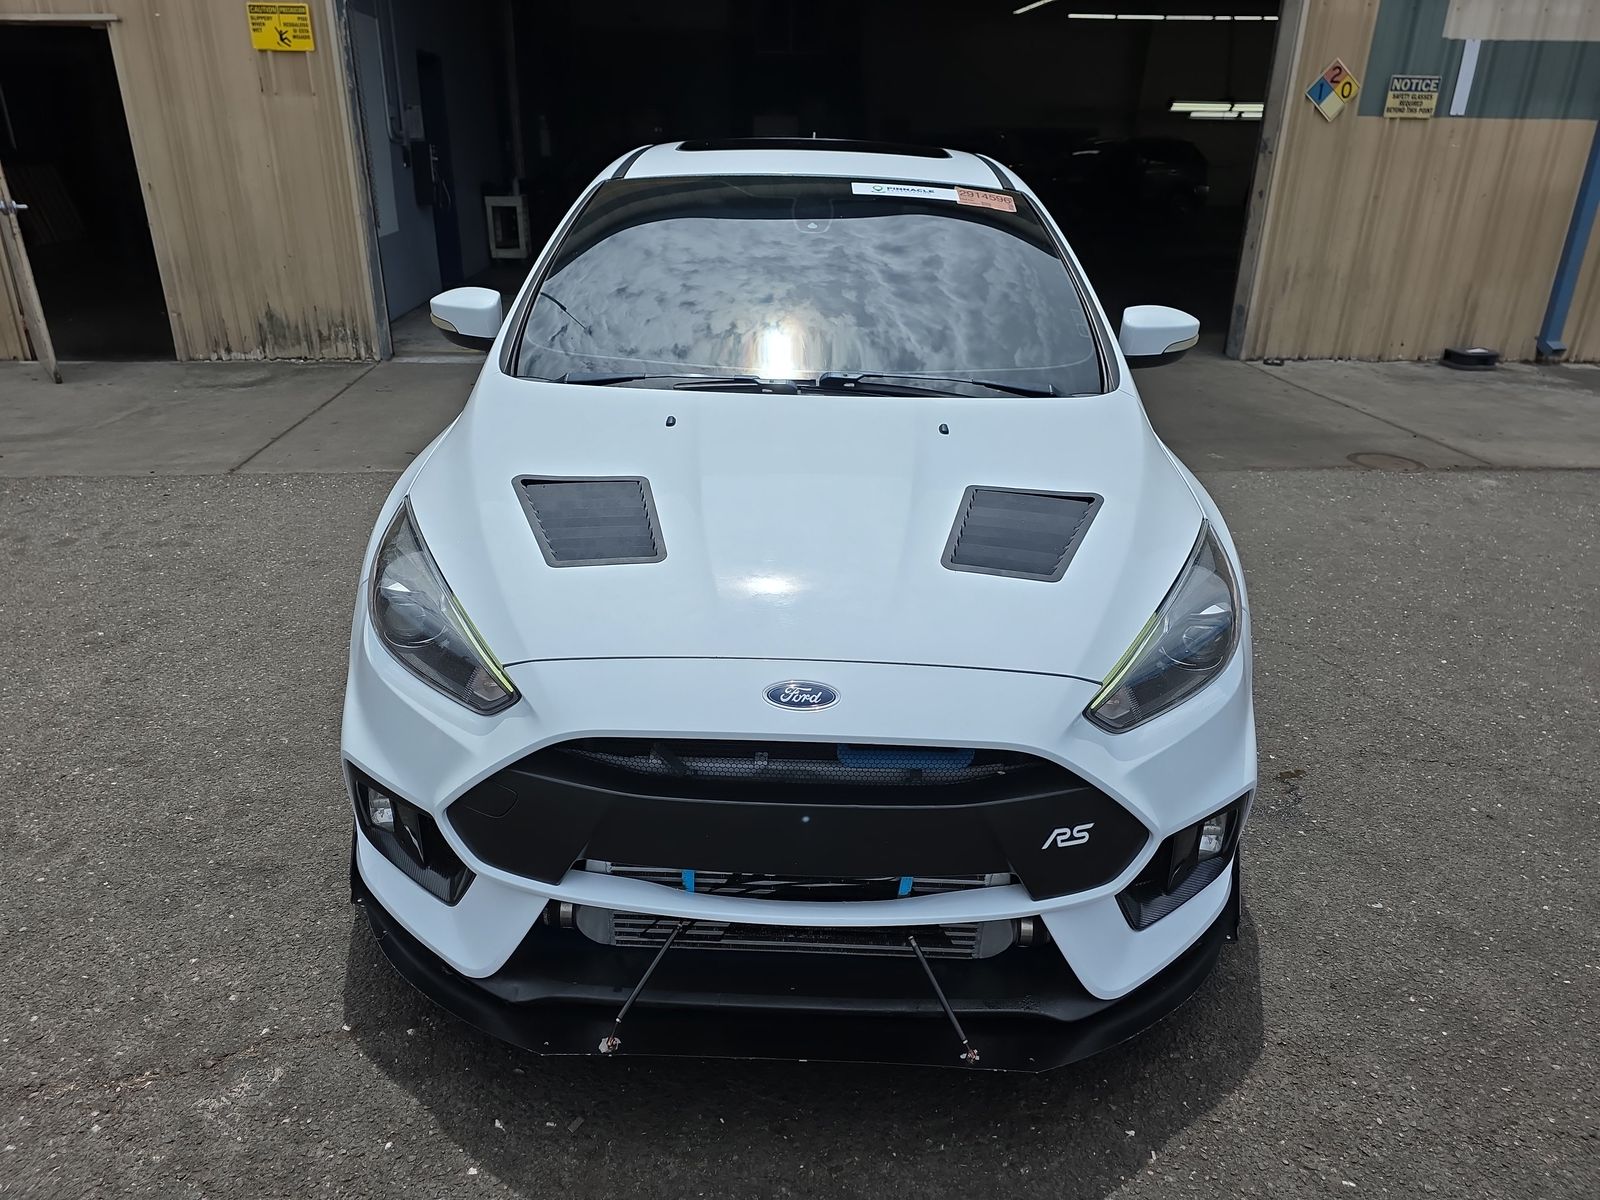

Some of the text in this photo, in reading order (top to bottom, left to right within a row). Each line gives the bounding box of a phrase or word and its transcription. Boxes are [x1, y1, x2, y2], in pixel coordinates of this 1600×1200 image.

[1330, 66, 1342, 83] 2
[1341, 81, 1352, 99] 0
[1391, 79, 1439, 91] NOTICE
[959, 190, 1013, 204] 2914596
[780, 687, 823, 703] Ford
[1041, 822, 1095, 850] RS
